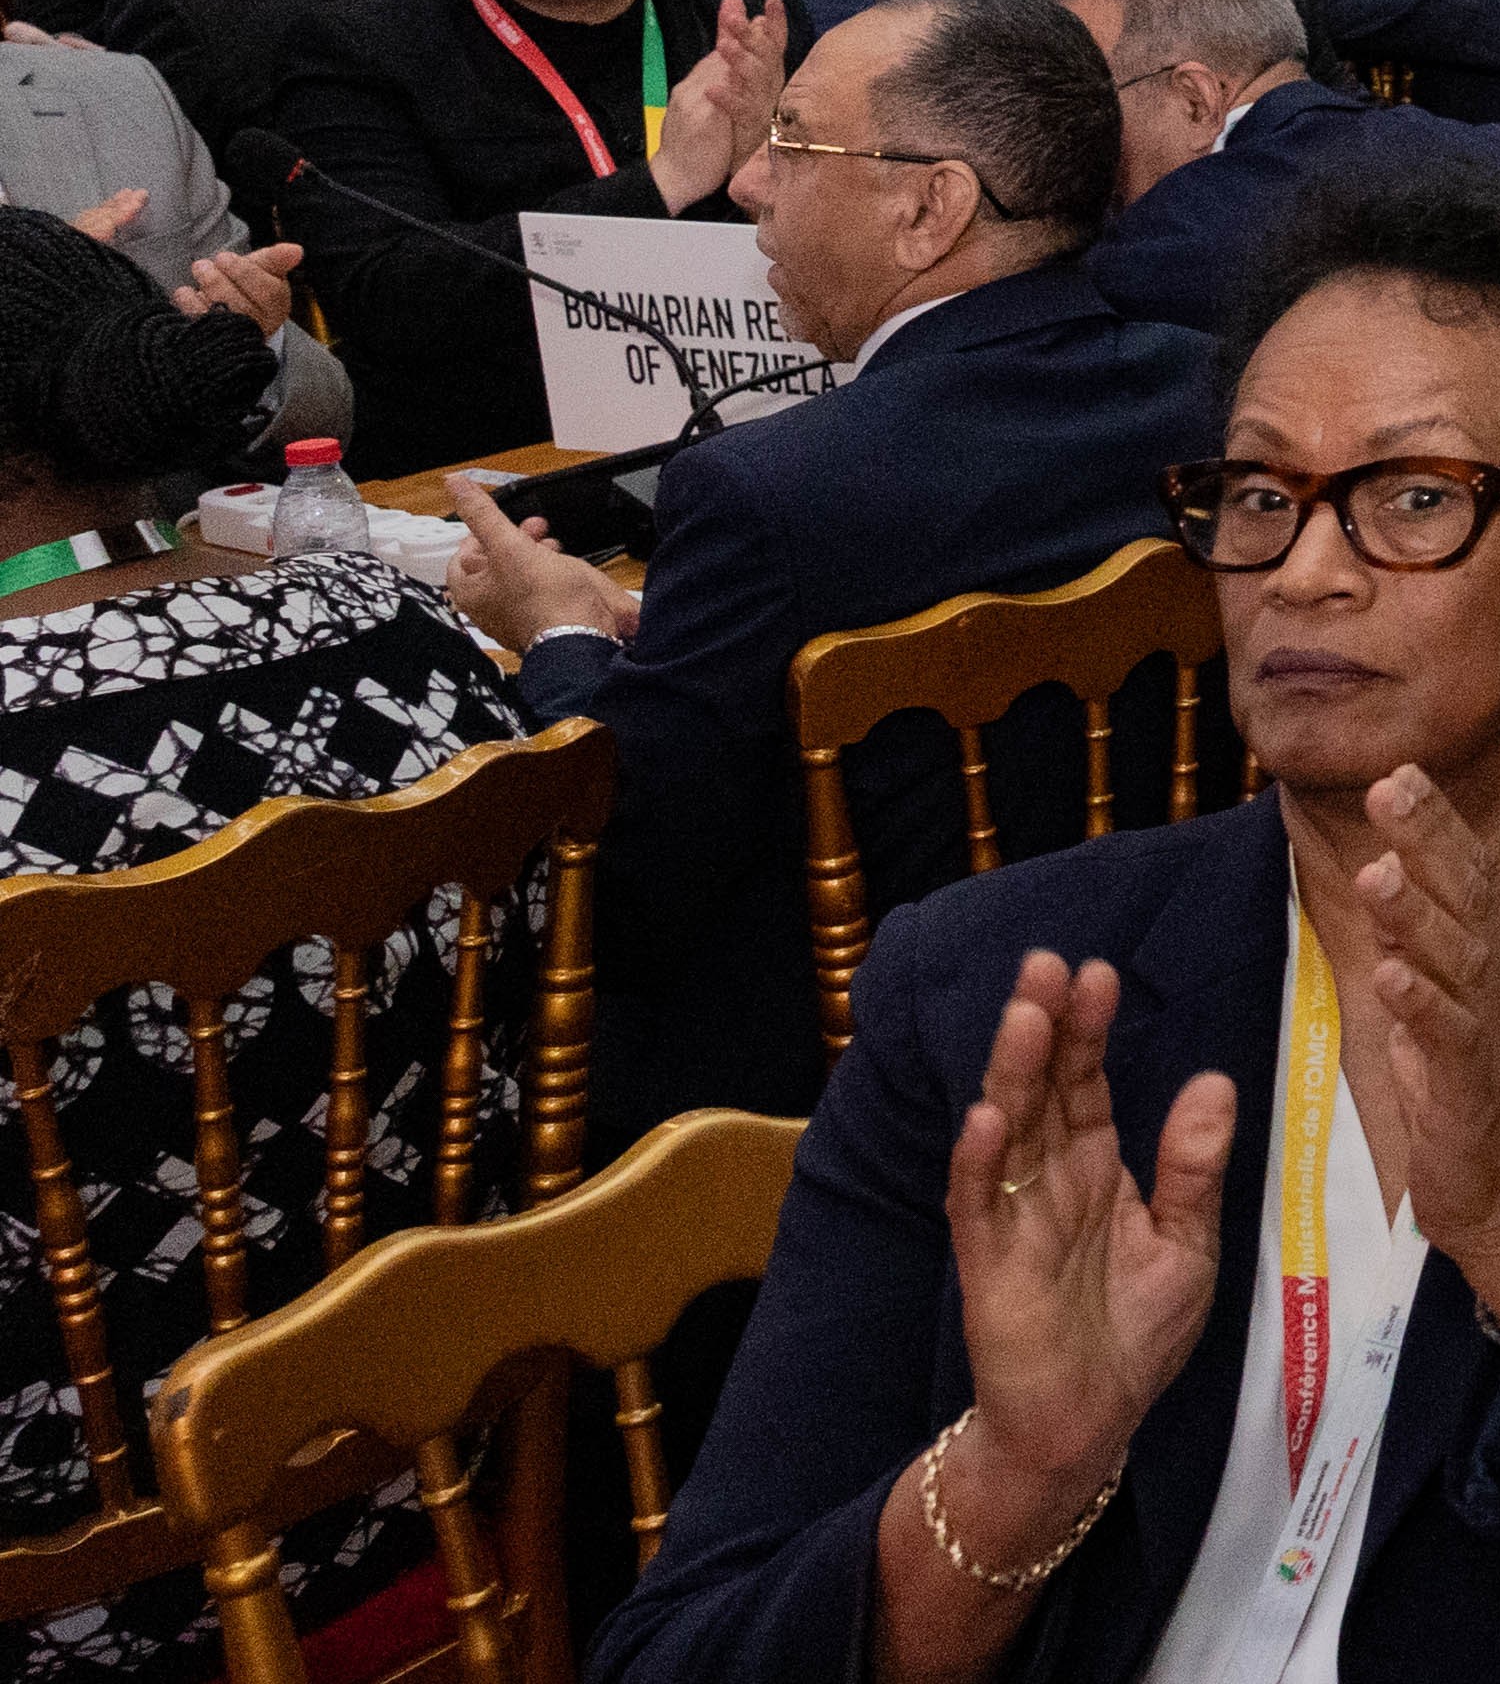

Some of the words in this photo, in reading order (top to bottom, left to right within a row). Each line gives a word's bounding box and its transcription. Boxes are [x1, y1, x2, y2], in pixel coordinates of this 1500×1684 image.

[563, 290, 737, 340] BOLIVARIAN
[626, 343, 660, 386] OF
[678, 347, 838, 397] VENEZUELA
[1304, 1020, 1330, 1101] l'OMC
[1301, 1106, 1321, 1139] de
[1297, 1142, 1318, 1296] Ministérielle
[1291, 1301, 1319, 1453] Conférence
